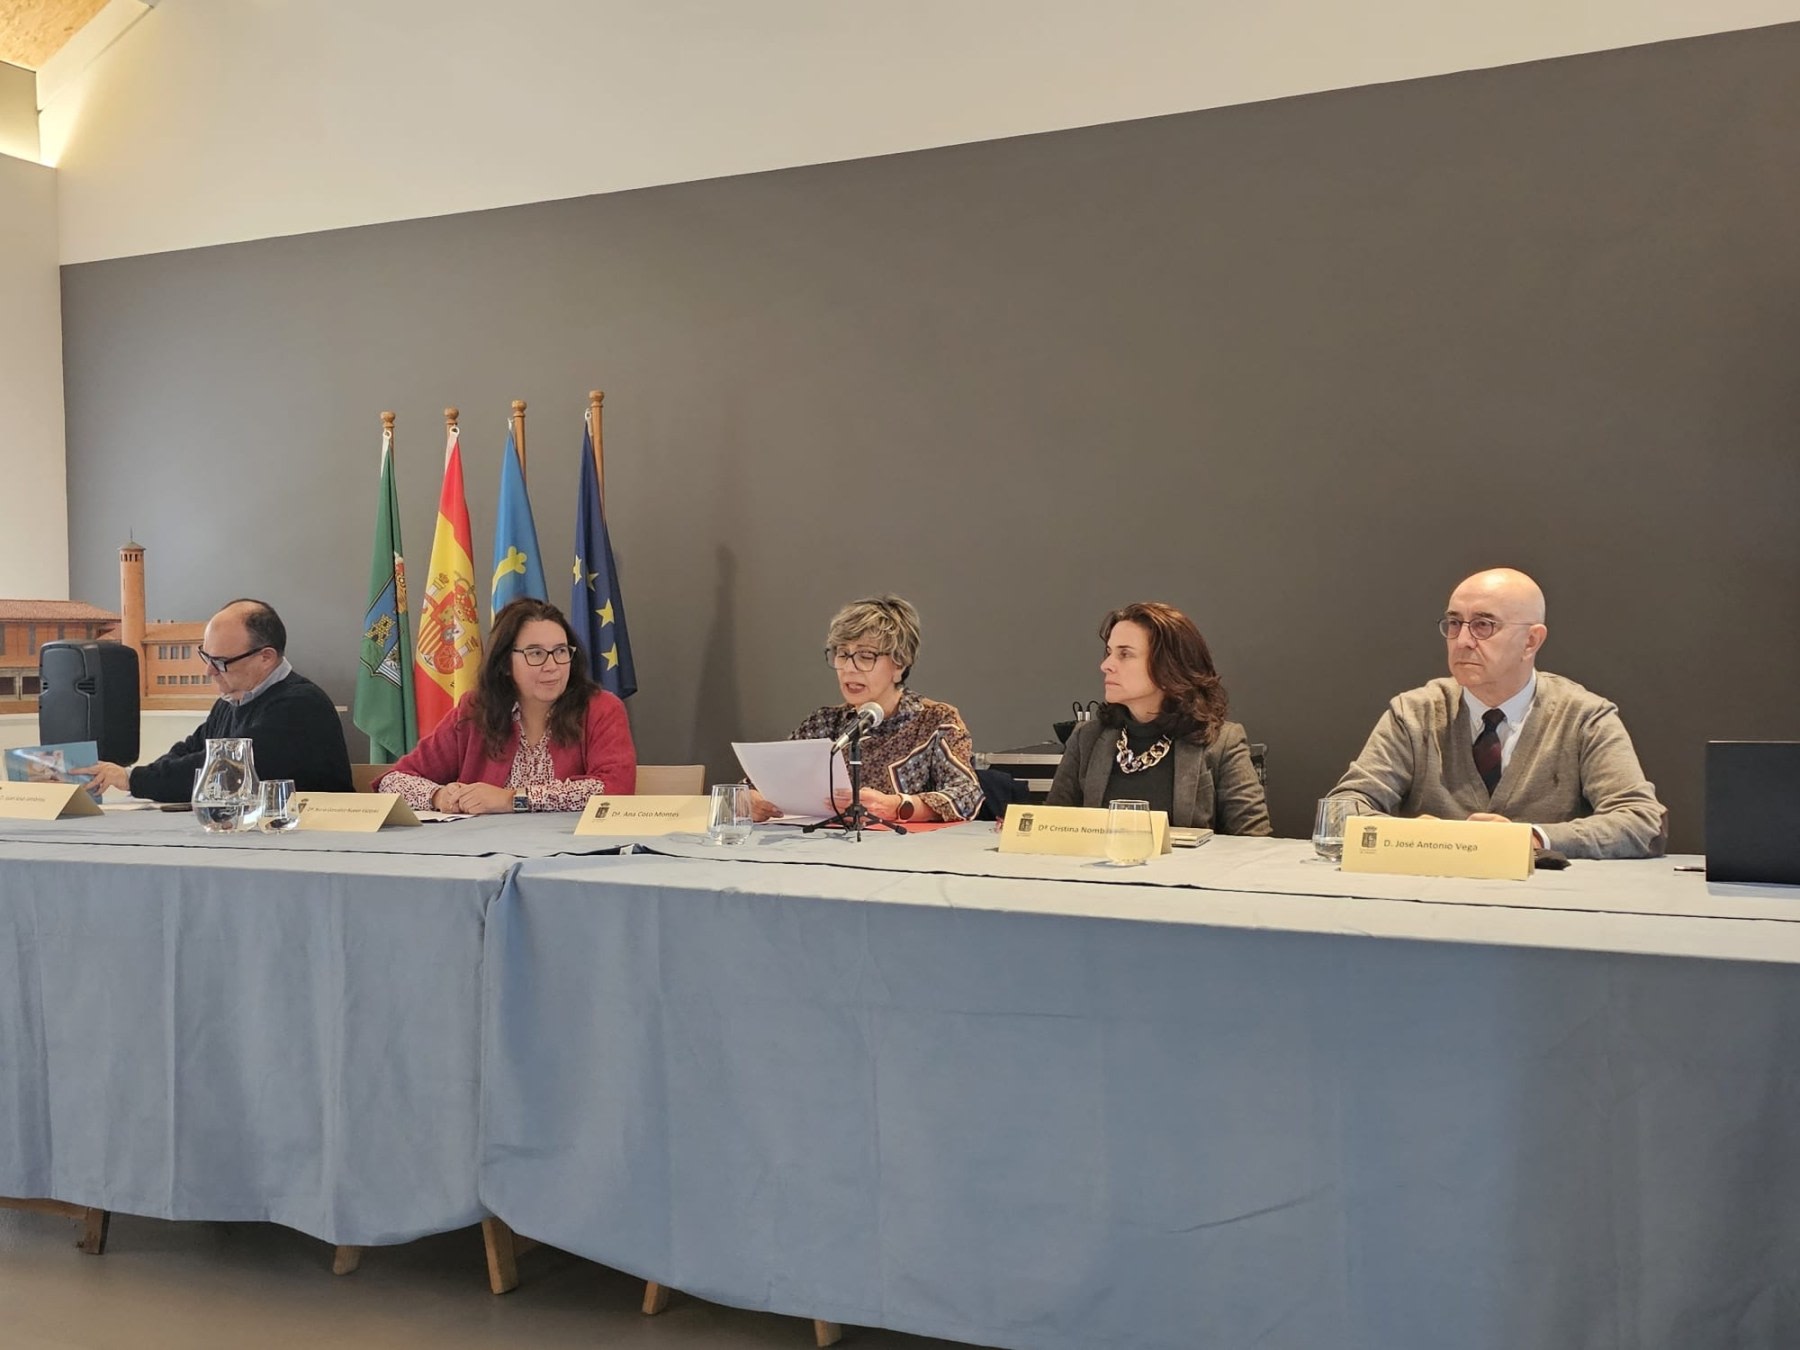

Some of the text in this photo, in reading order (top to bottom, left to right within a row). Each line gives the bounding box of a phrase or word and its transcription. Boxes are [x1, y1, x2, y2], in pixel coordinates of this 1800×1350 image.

[1049, 824, 1079, 833] Cristina
[1383, 839, 1478, 853] D. José Antonio Vega
